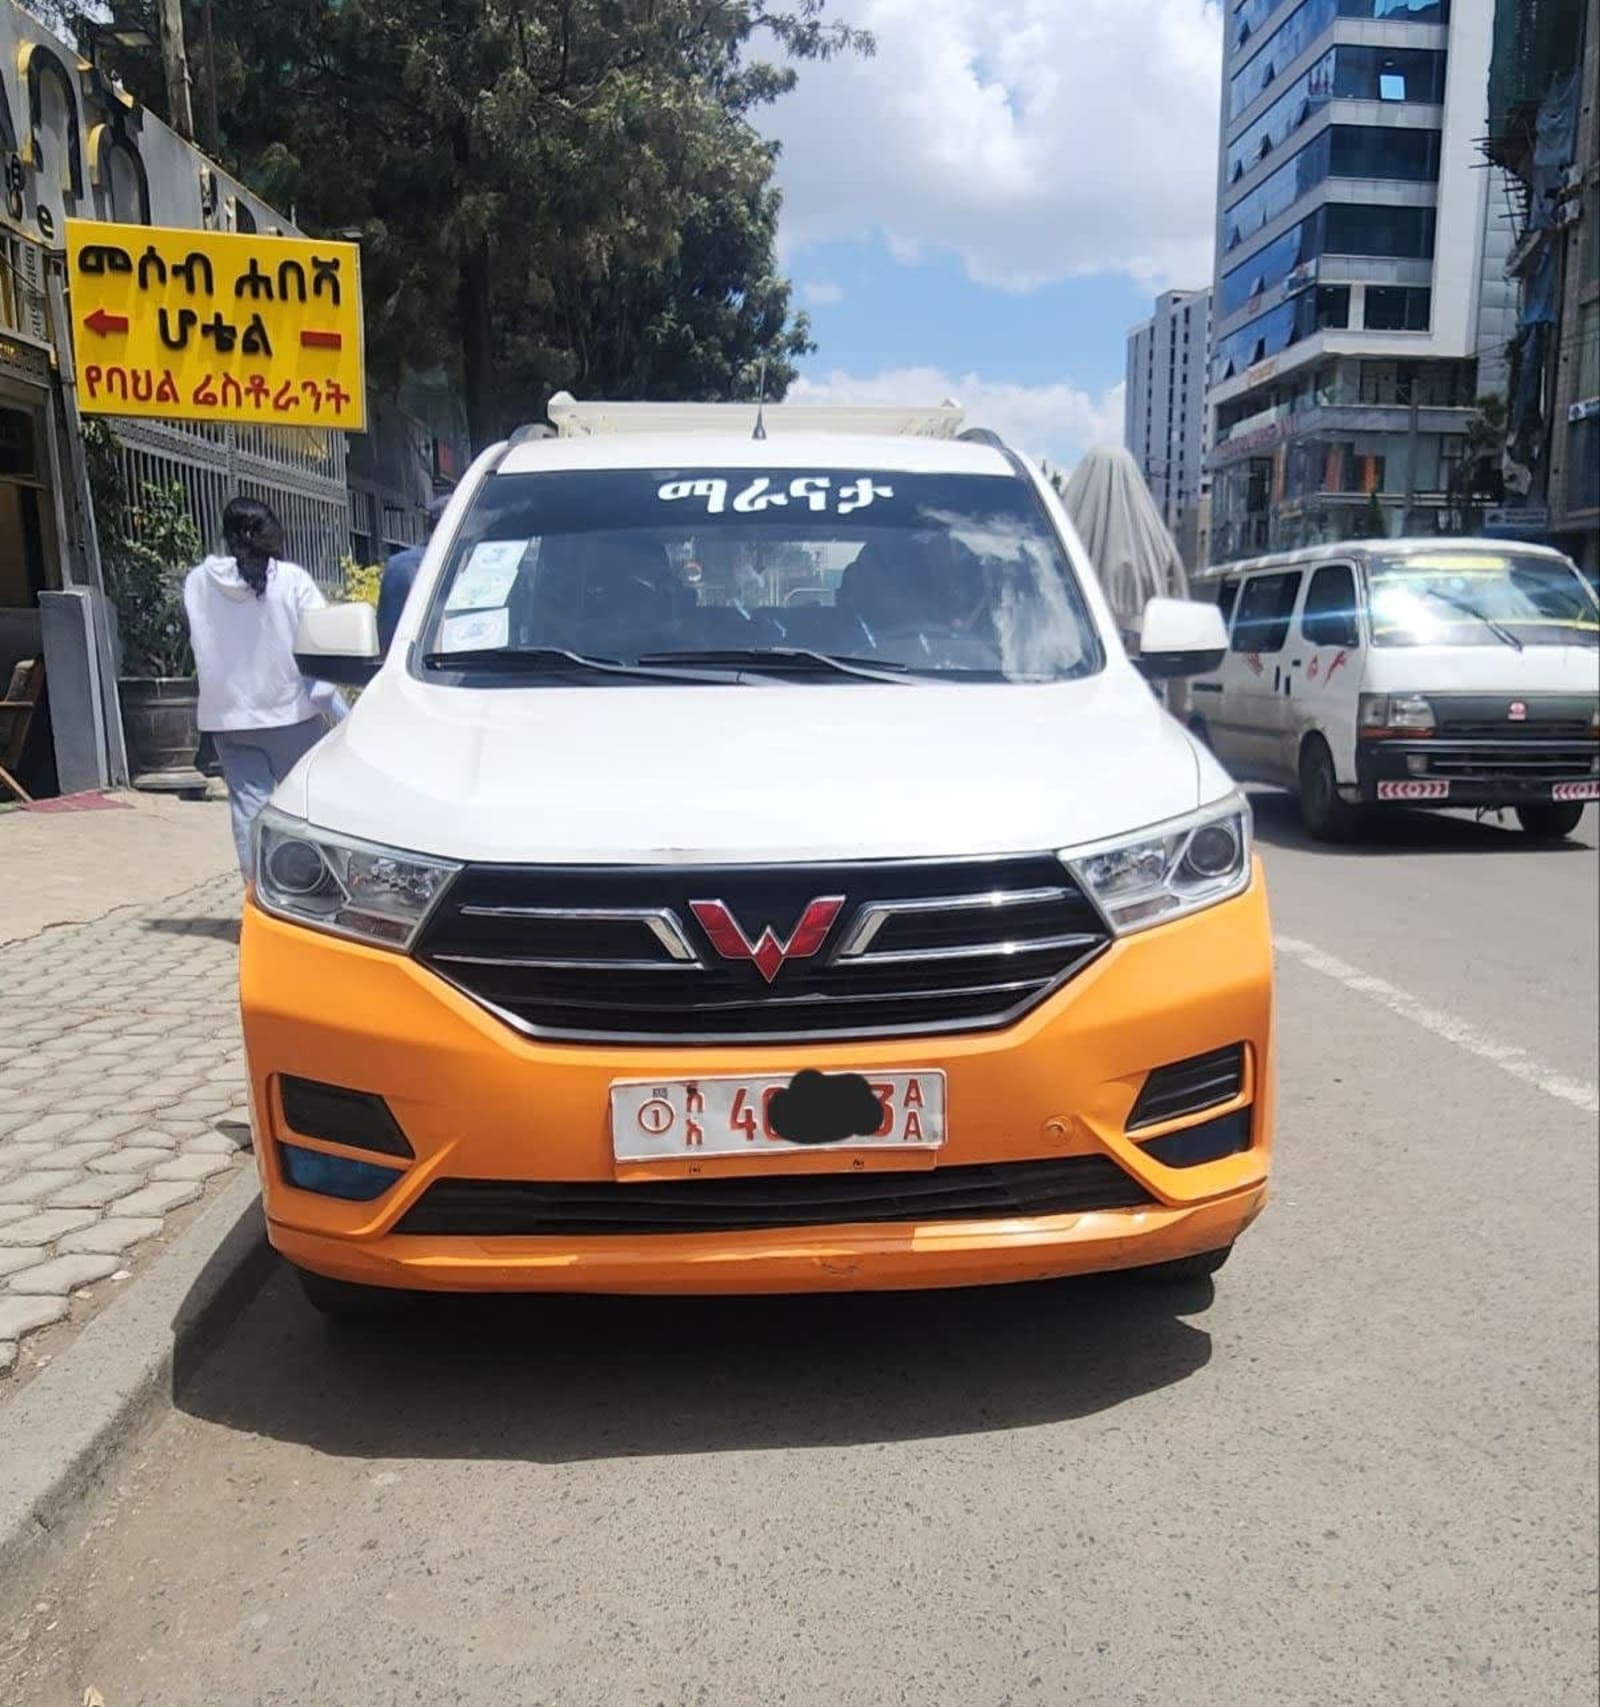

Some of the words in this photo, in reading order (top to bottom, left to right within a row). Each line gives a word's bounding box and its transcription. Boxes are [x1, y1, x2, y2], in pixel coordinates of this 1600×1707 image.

[78, 245, 214, 295] መሶብ
[235, 257, 341, 306] ሐበሻ
[158, 307, 272, 357] ሆቴል
[85, 365, 180, 404] የባህል
[193, 372, 350, 415] ሬስቶራንት
[657, 477, 894, 514] ማራናታ
